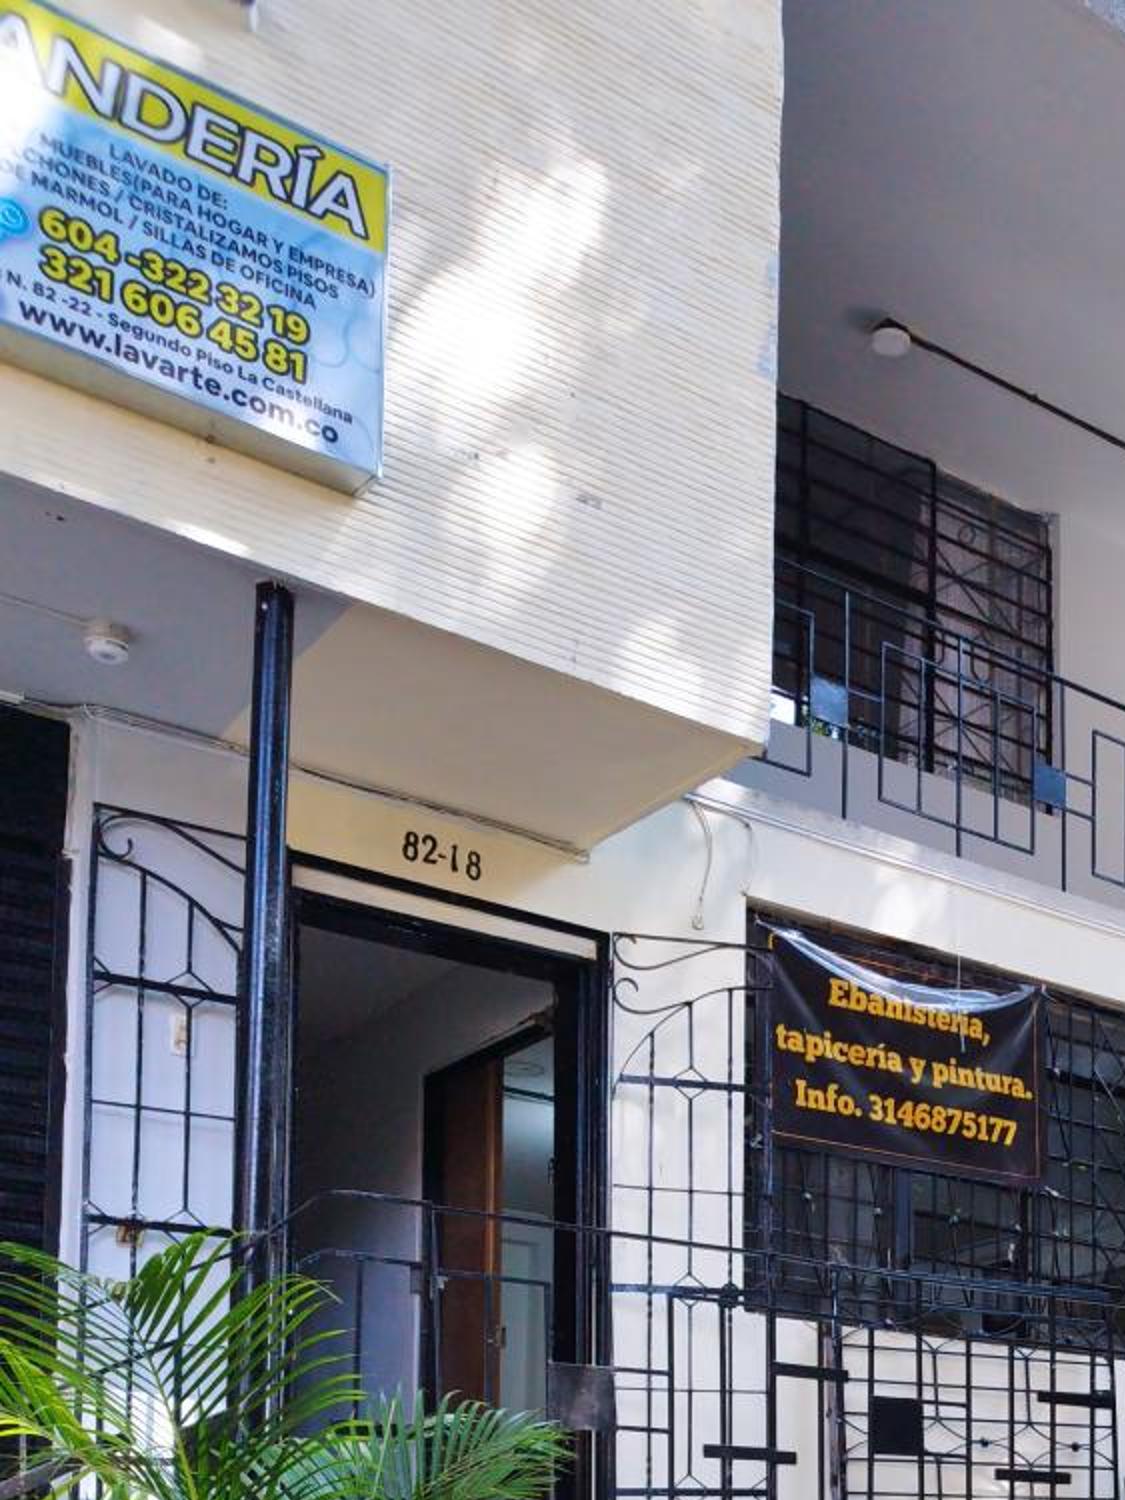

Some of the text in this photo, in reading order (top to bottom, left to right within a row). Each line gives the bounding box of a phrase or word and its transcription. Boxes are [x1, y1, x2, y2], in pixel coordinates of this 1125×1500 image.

[109, 144, 228, 211] LAVADO DE:
[31, 170, 123, 224] MARMOL
[142, 219, 206, 260] SILLAS
[211, 250, 236, 273] DE
[240, 264, 317, 310] OFICINA
[38, 206, 121, 266] 604
[216, 281, 264, 328] 32
[267, 303, 311, 346] 19
[128, 193, 288, 274] CRISTALIZAMOS
[288, 264, 339, 299] PISOS
[197, 203, 273, 248] HOGAR
[272, 237, 284, 254] Y
[289, 246, 375, 298] EMPRESA)
[6, 269, 28, 291] N.
[108, 312, 191, 360] Segundo
[197, 344, 234, 374] Piso
[237, 362, 259, 385] La
[262, 377, 353, 425] Castellana
[38, 243, 309, 386] 321 606 45 81
[19, 300, 339, 444] www.lavarte.com.co
[402, 831, 482, 881] 82-18
[776, 1023, 1034, 1101] tapicería y pintura.
[795, 1079, 1018, 1147] Info. 3146875177
